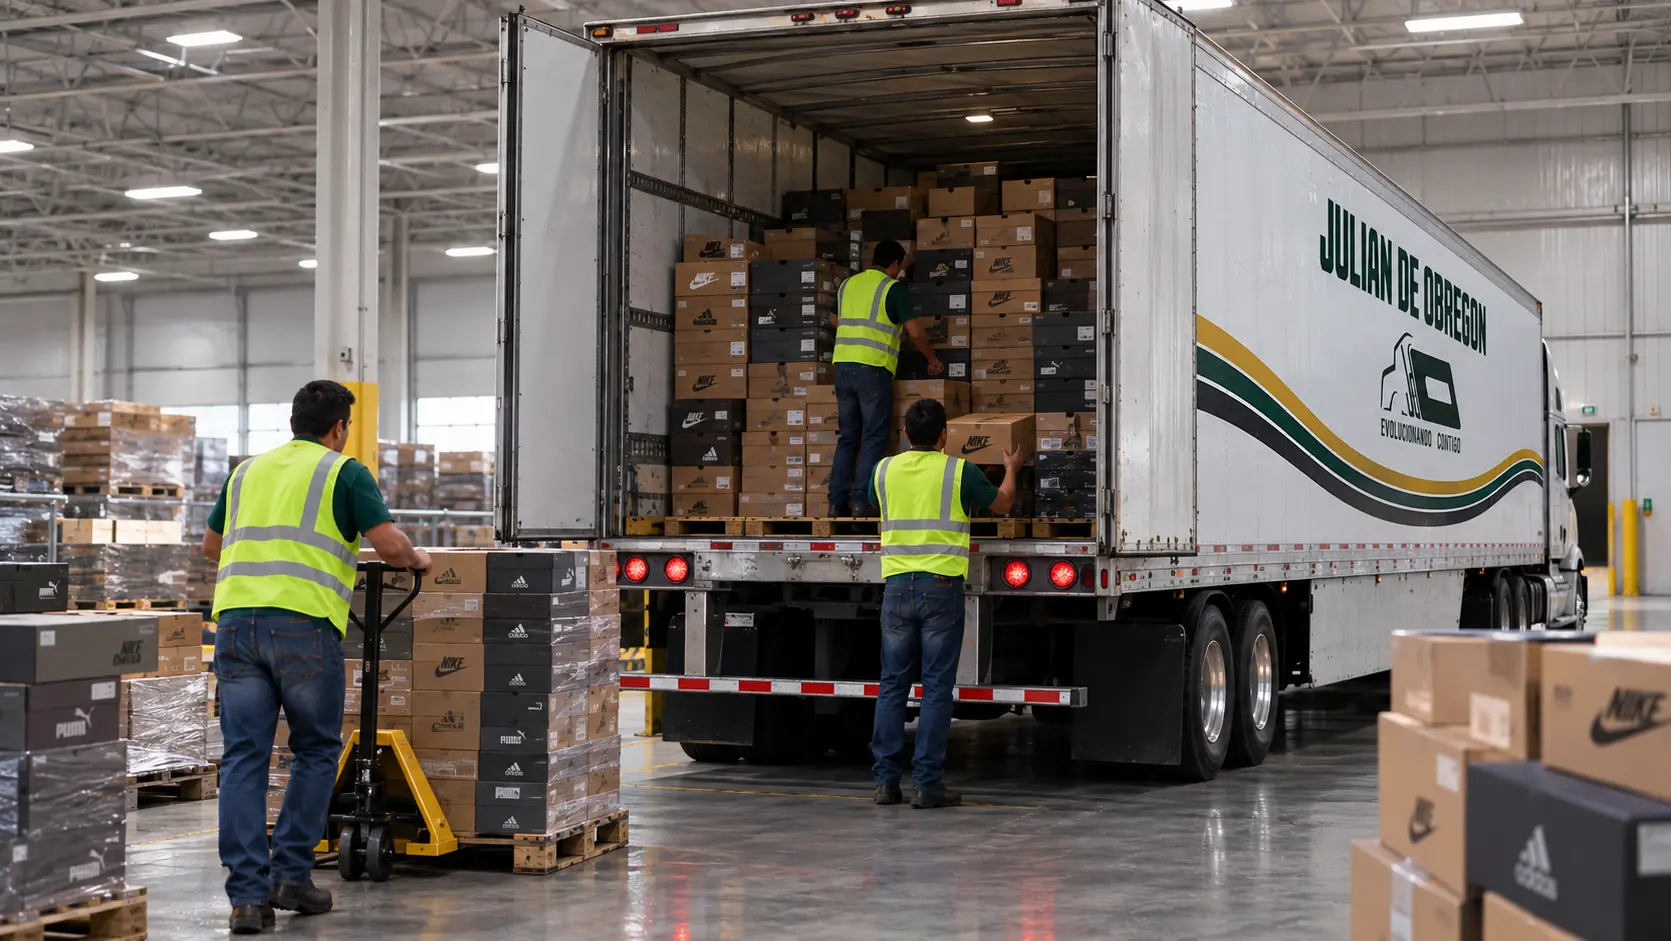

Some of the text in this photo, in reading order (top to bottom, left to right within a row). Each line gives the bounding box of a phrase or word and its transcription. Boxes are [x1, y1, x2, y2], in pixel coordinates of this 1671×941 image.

[1319, 197, 1487, 356] JULIAN DE OBREGON
[966, 435, 991, 447] NIKE
[1380, 417, 1461, 454] EVOLUCIONANDO CONTIGO
[441, 656, 465, 669] NIKE
[1605, 686, 1667, 722] NIKE
